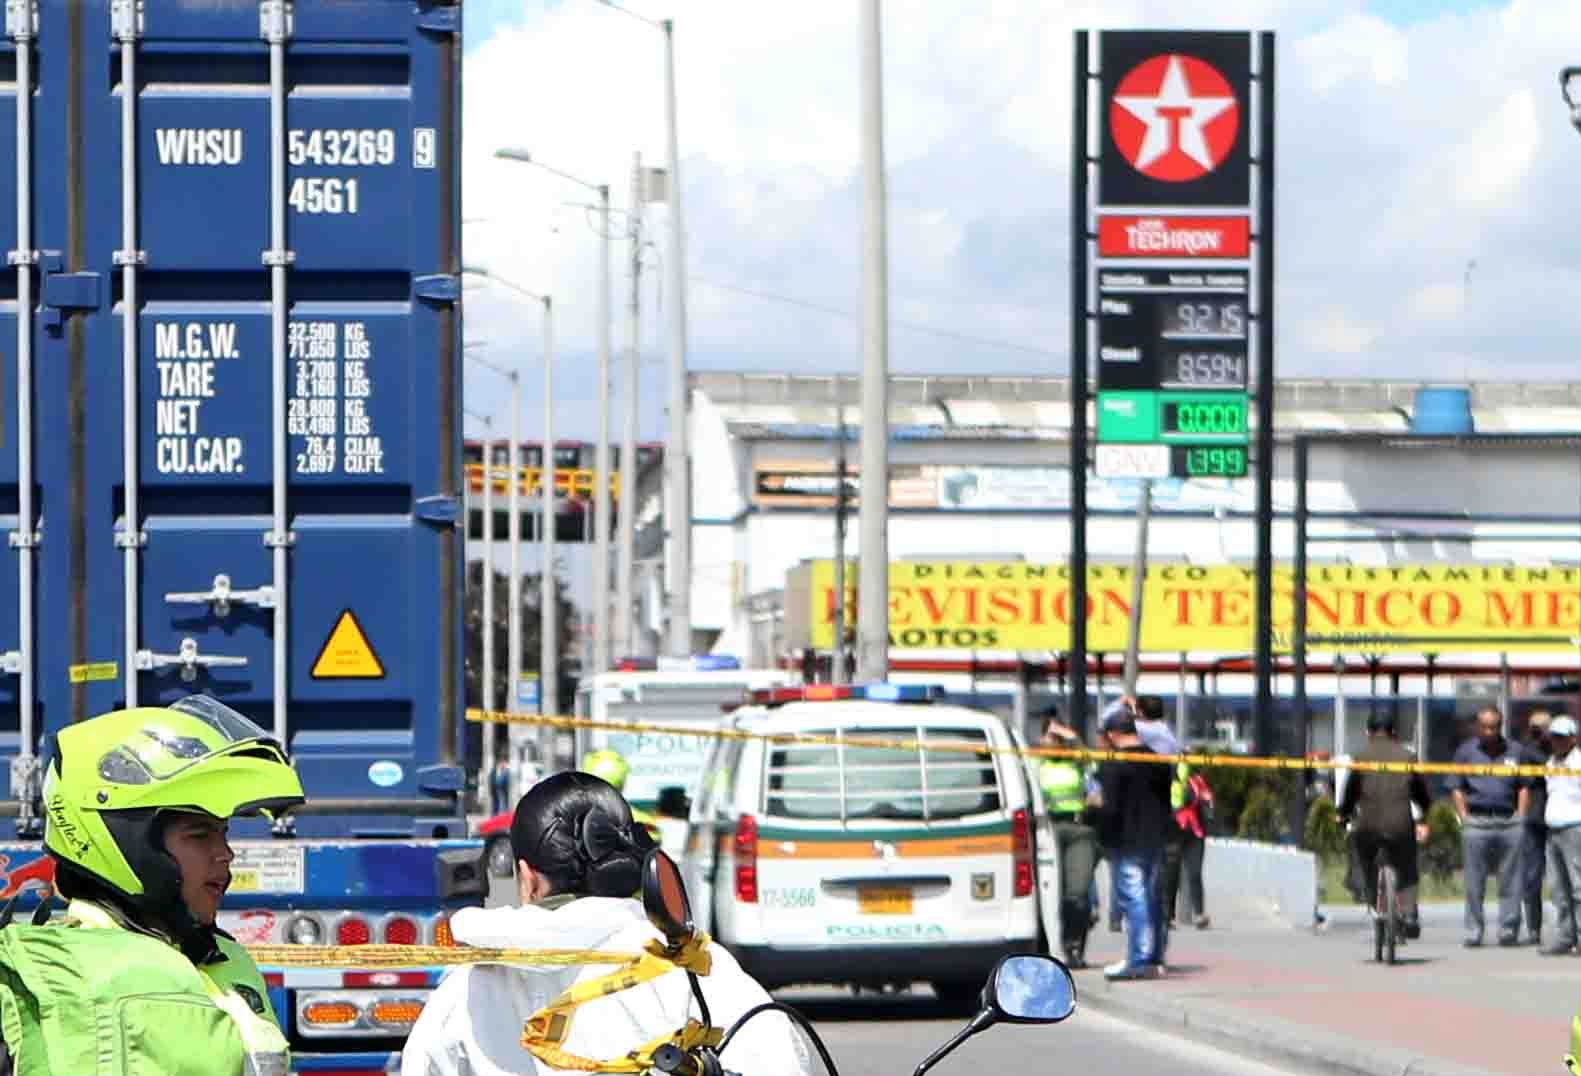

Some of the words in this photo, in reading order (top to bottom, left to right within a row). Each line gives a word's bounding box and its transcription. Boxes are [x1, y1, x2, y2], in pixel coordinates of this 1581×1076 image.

[155, 129, 242, 165] WHSU
[288, 130, 395, 165] 543269
[416, 130, 434, 165] 9
[288, 179, 357, 213] 45G1
[1124, 226, 1222, 254] TECHRON
[155, 323, 240, 359] M.G.W.
[344, 323, 364, 340] KG
[344, 341, 370, 358] LBS
[157, 362, 215, 396] TARE
[344, 361, 364, 378] KG
[344, 379, 370, 396] LBS
[157, 400, 201, 435] NET
[344, 400, 364, 417] KG
[344, 418, 370, 434] LBS
[157, 437, 244, 473] CU.CAP.
